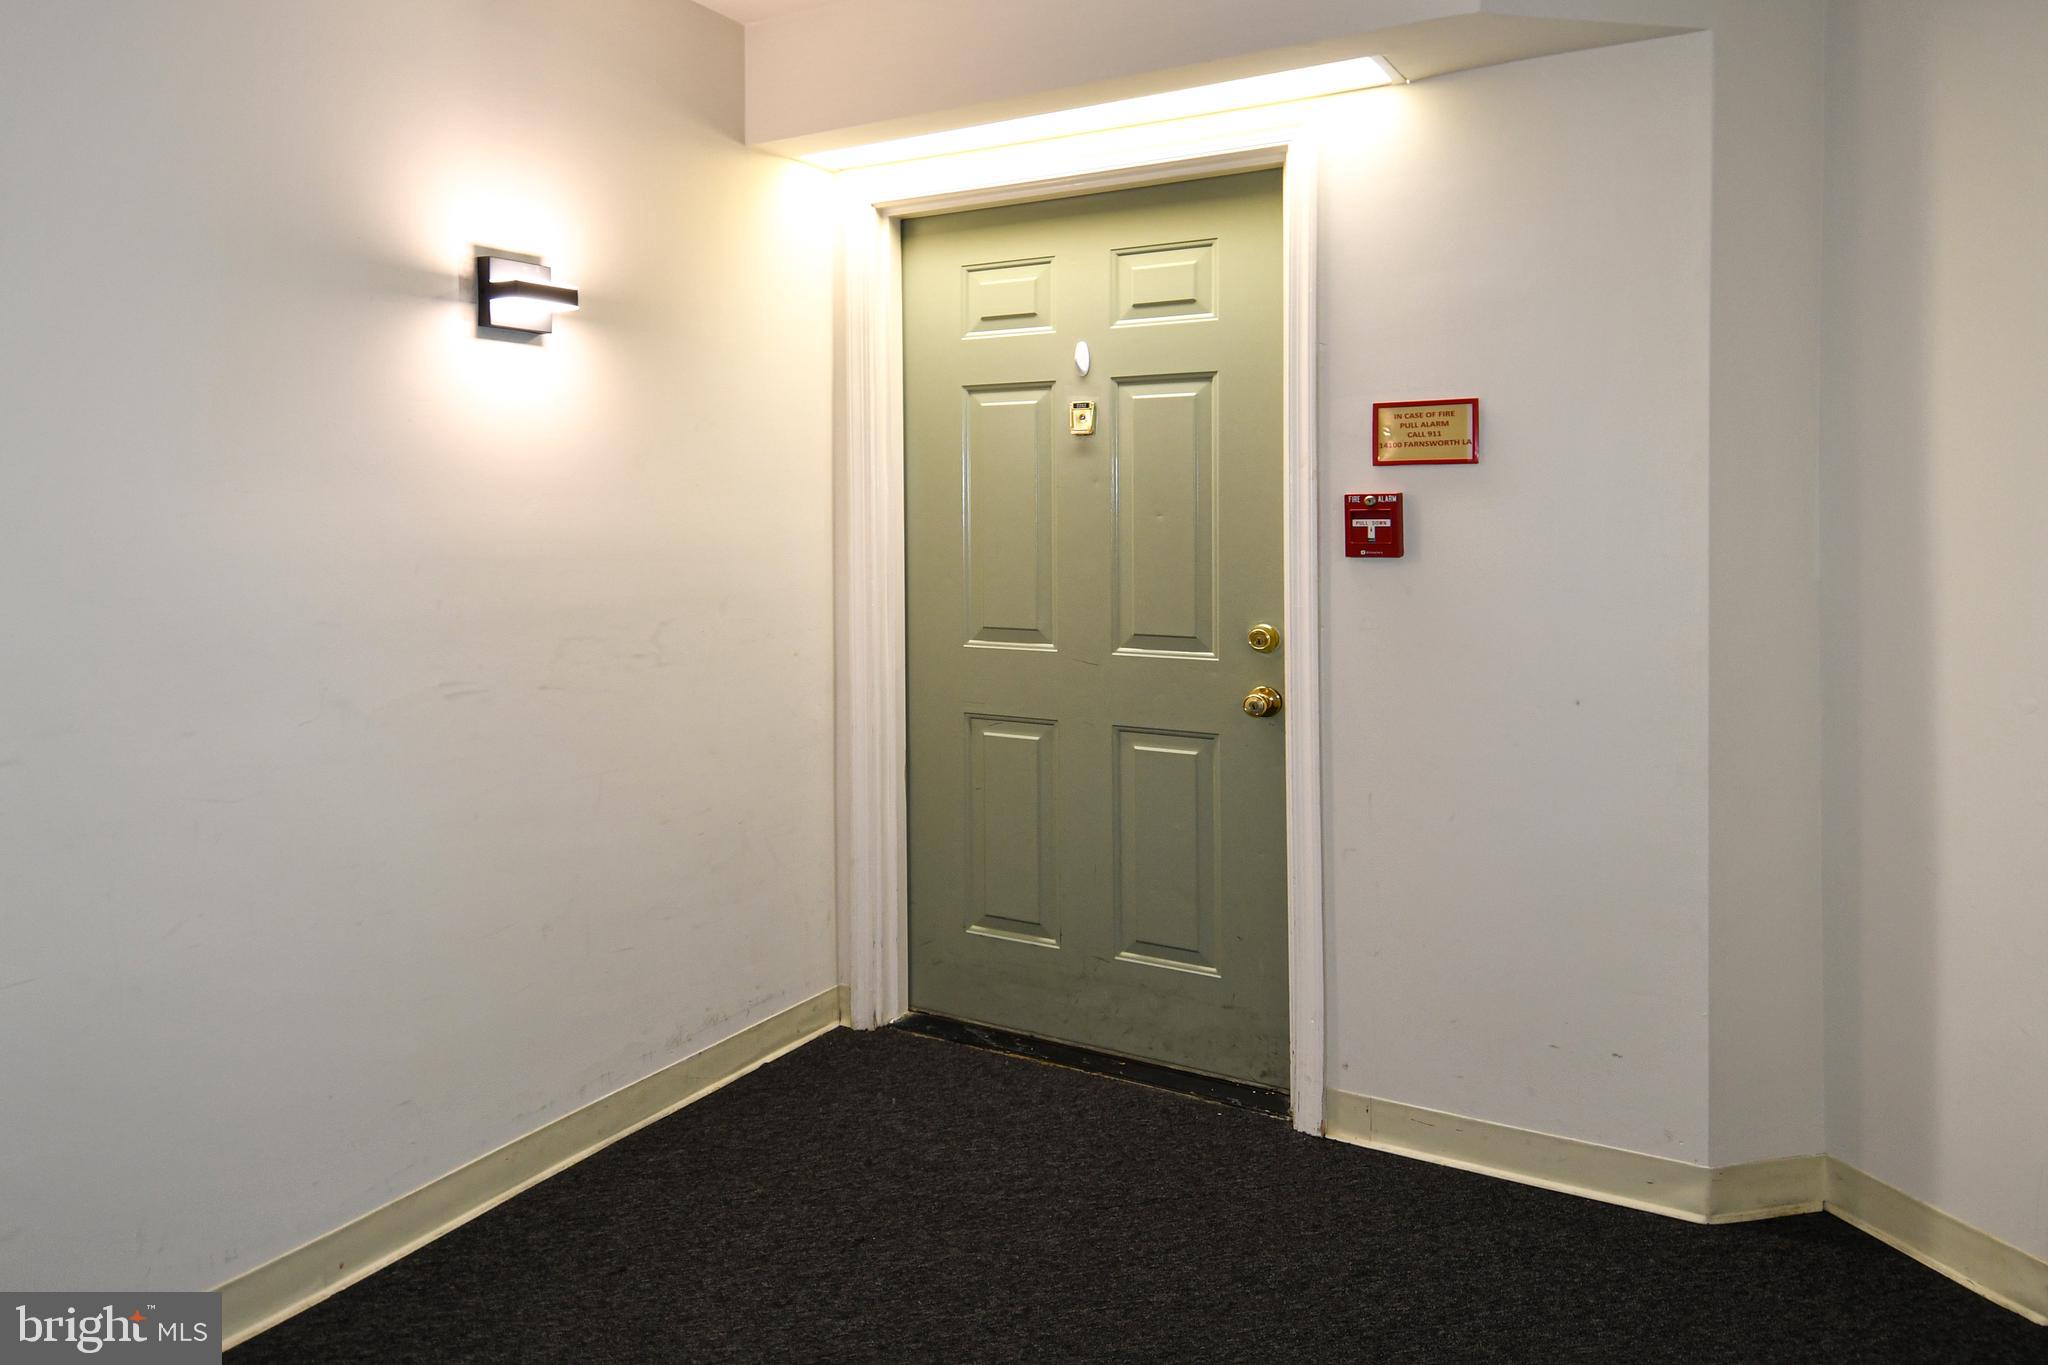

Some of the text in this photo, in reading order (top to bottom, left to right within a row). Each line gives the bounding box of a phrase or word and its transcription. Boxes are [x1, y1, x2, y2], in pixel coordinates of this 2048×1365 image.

[1404, 412, 1423, 420] CASE
[1420, 420, 1450, 428] ALARM
[1403, 439, 1460, 448] FARNSWORTH
[1348, 495, 1361, 503] FIRE
